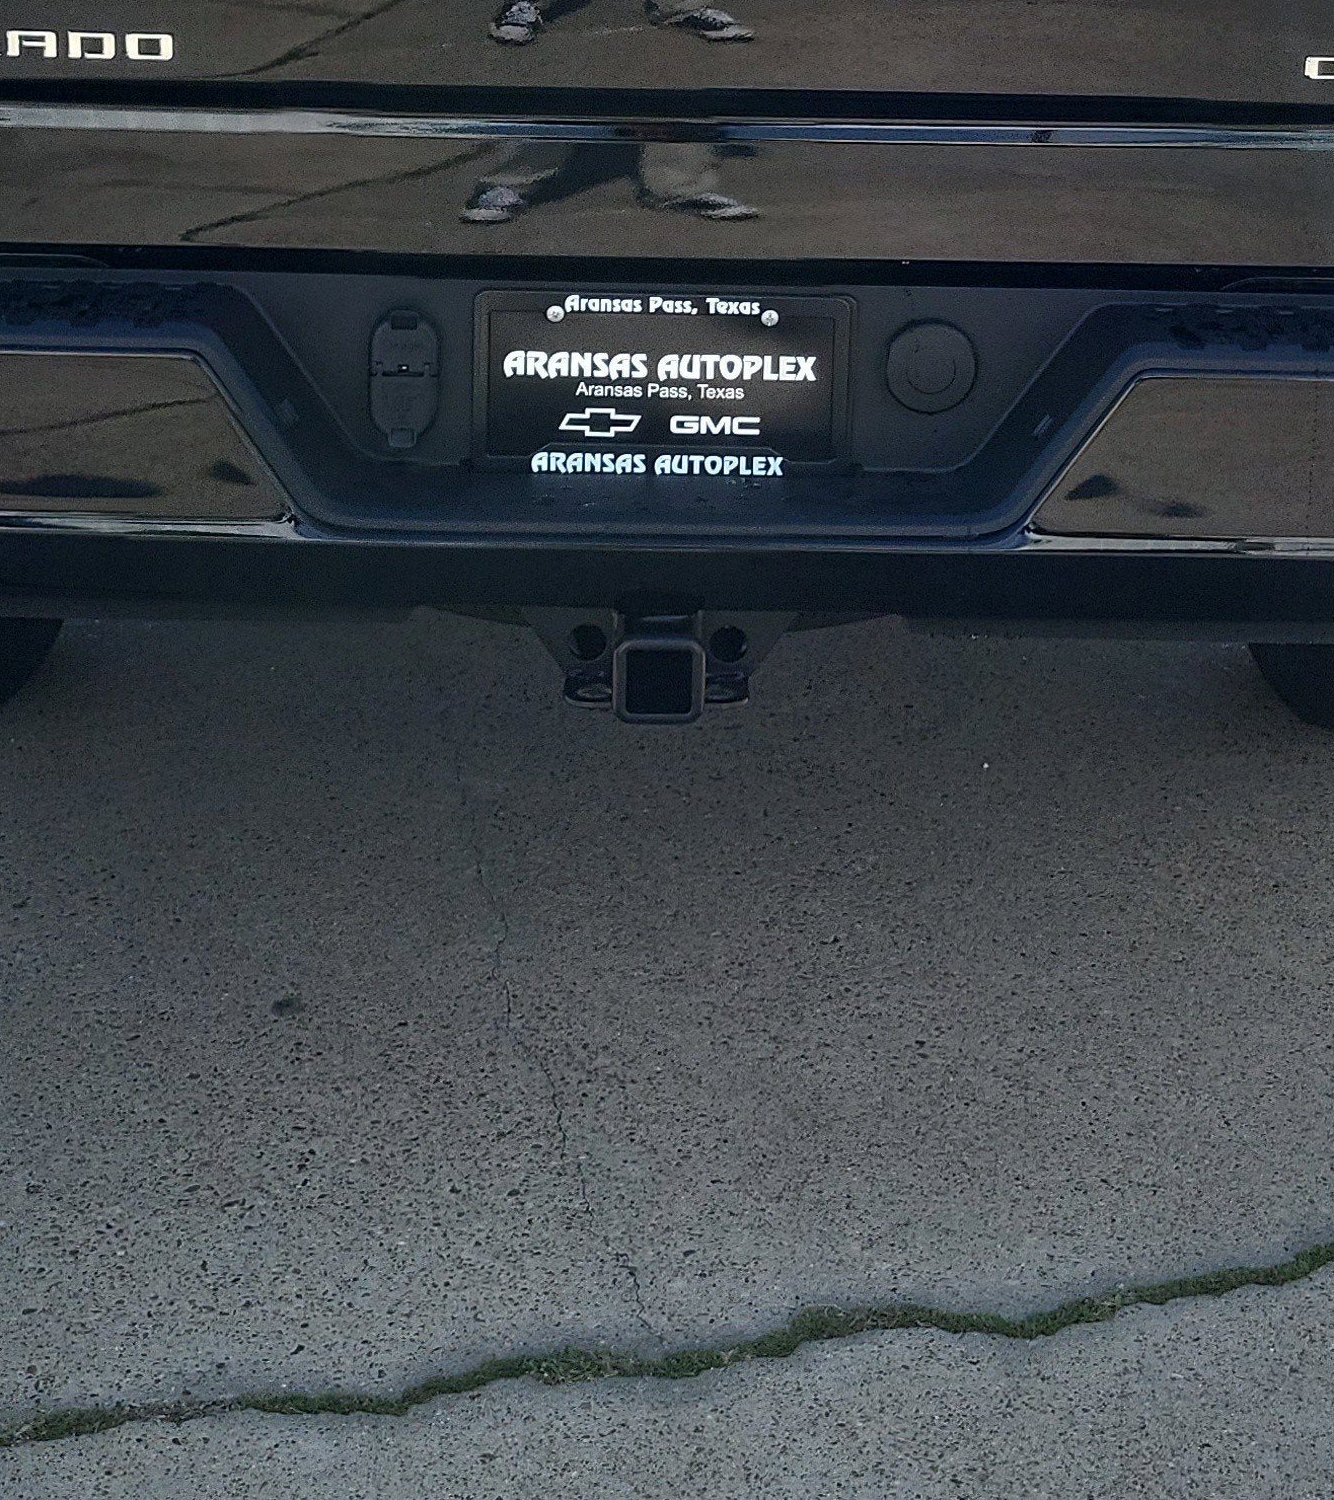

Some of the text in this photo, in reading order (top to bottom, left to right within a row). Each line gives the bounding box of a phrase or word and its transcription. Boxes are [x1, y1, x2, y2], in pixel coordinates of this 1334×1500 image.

[565, 295, 761, 315] Aransas Pass, Texas
[503, 350, 817, 381] ARANSAS AUTOPLEX
[575, 381, 745, 400] Aransas Pass, Texas
[669, 415, 761, 435] GMC
[531, 452, 784, 476] ARANSAS AUTOPLEX
